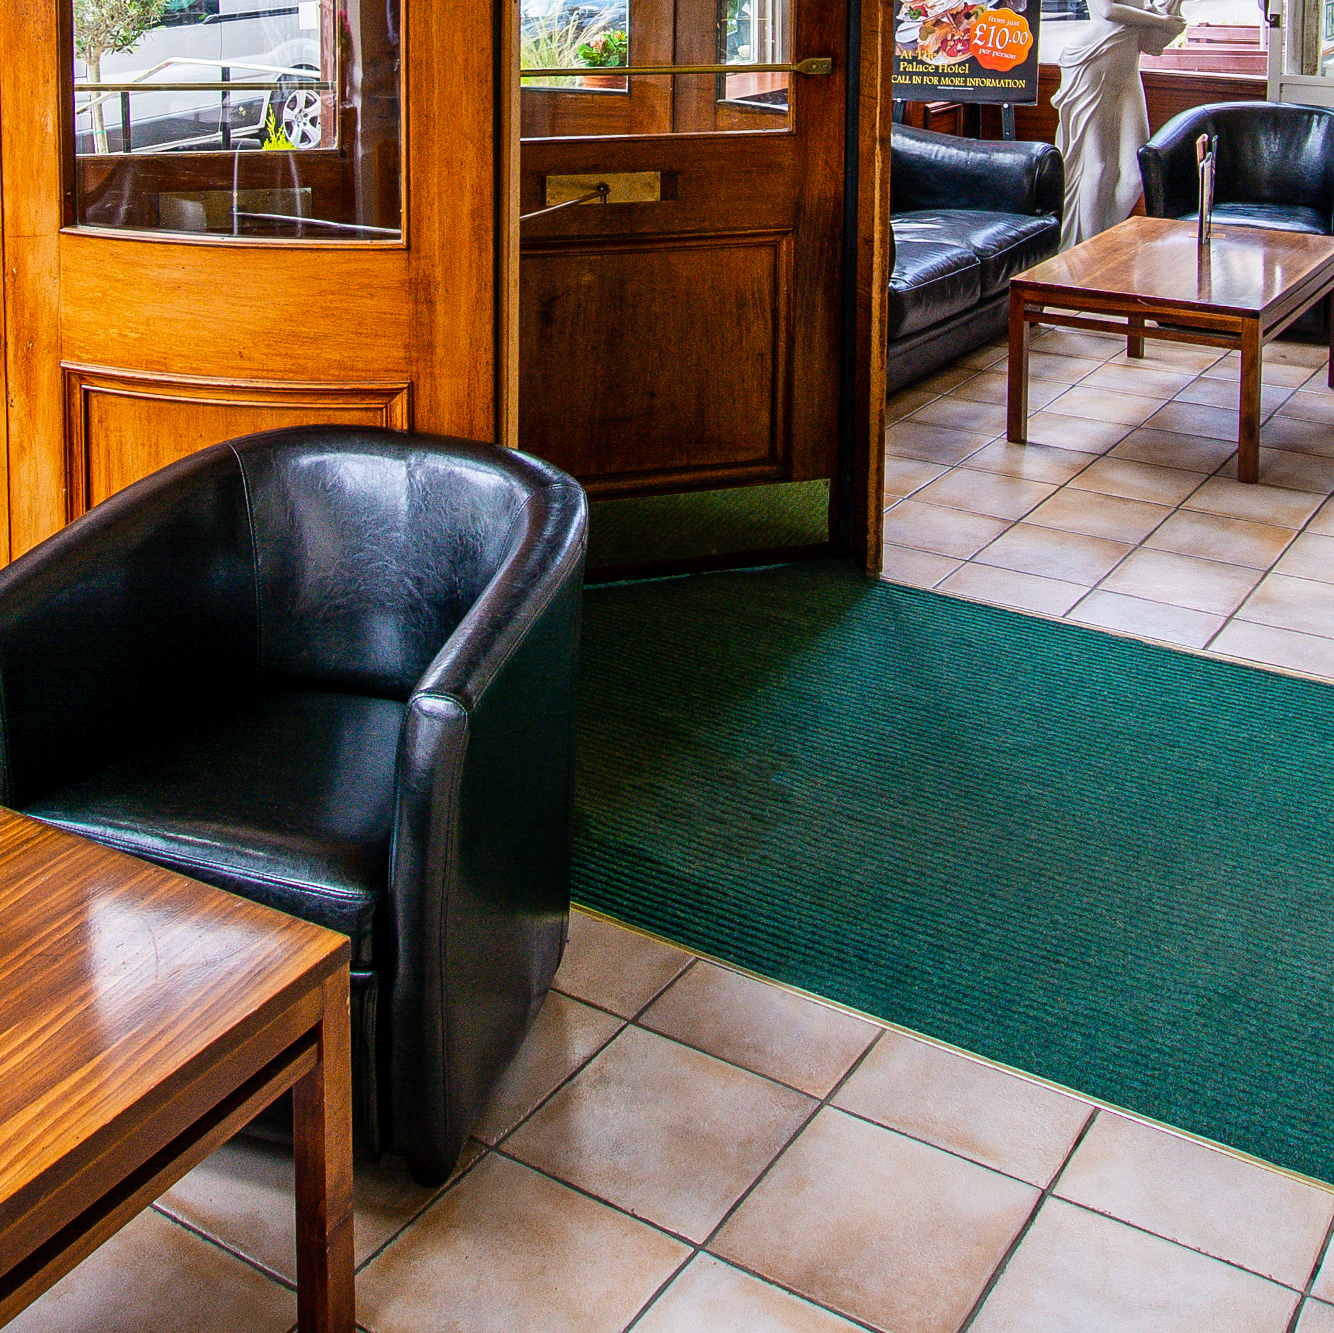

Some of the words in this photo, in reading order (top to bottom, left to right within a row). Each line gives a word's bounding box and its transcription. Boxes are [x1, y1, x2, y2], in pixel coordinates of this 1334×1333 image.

[988, 15, 1006, 24] from
[1007, 18, 1020, 26] just
[972, 23, 1028, 50] £10.00
[900, 50, 913, 60] At
[915, 51, 937, 60] The
[992, 50, 1017, 60] person
[899, 62, 935, 72] Palace
[939, 63, 969, 73] Hotel
[892, 75, 911, 84] CALL
[912, 76, 922, 84] IN
[923, 76, 939, 84] FOR
[941, 77, 965, 86] MORE
[967, 78, 1025, 88] INFORMATION
